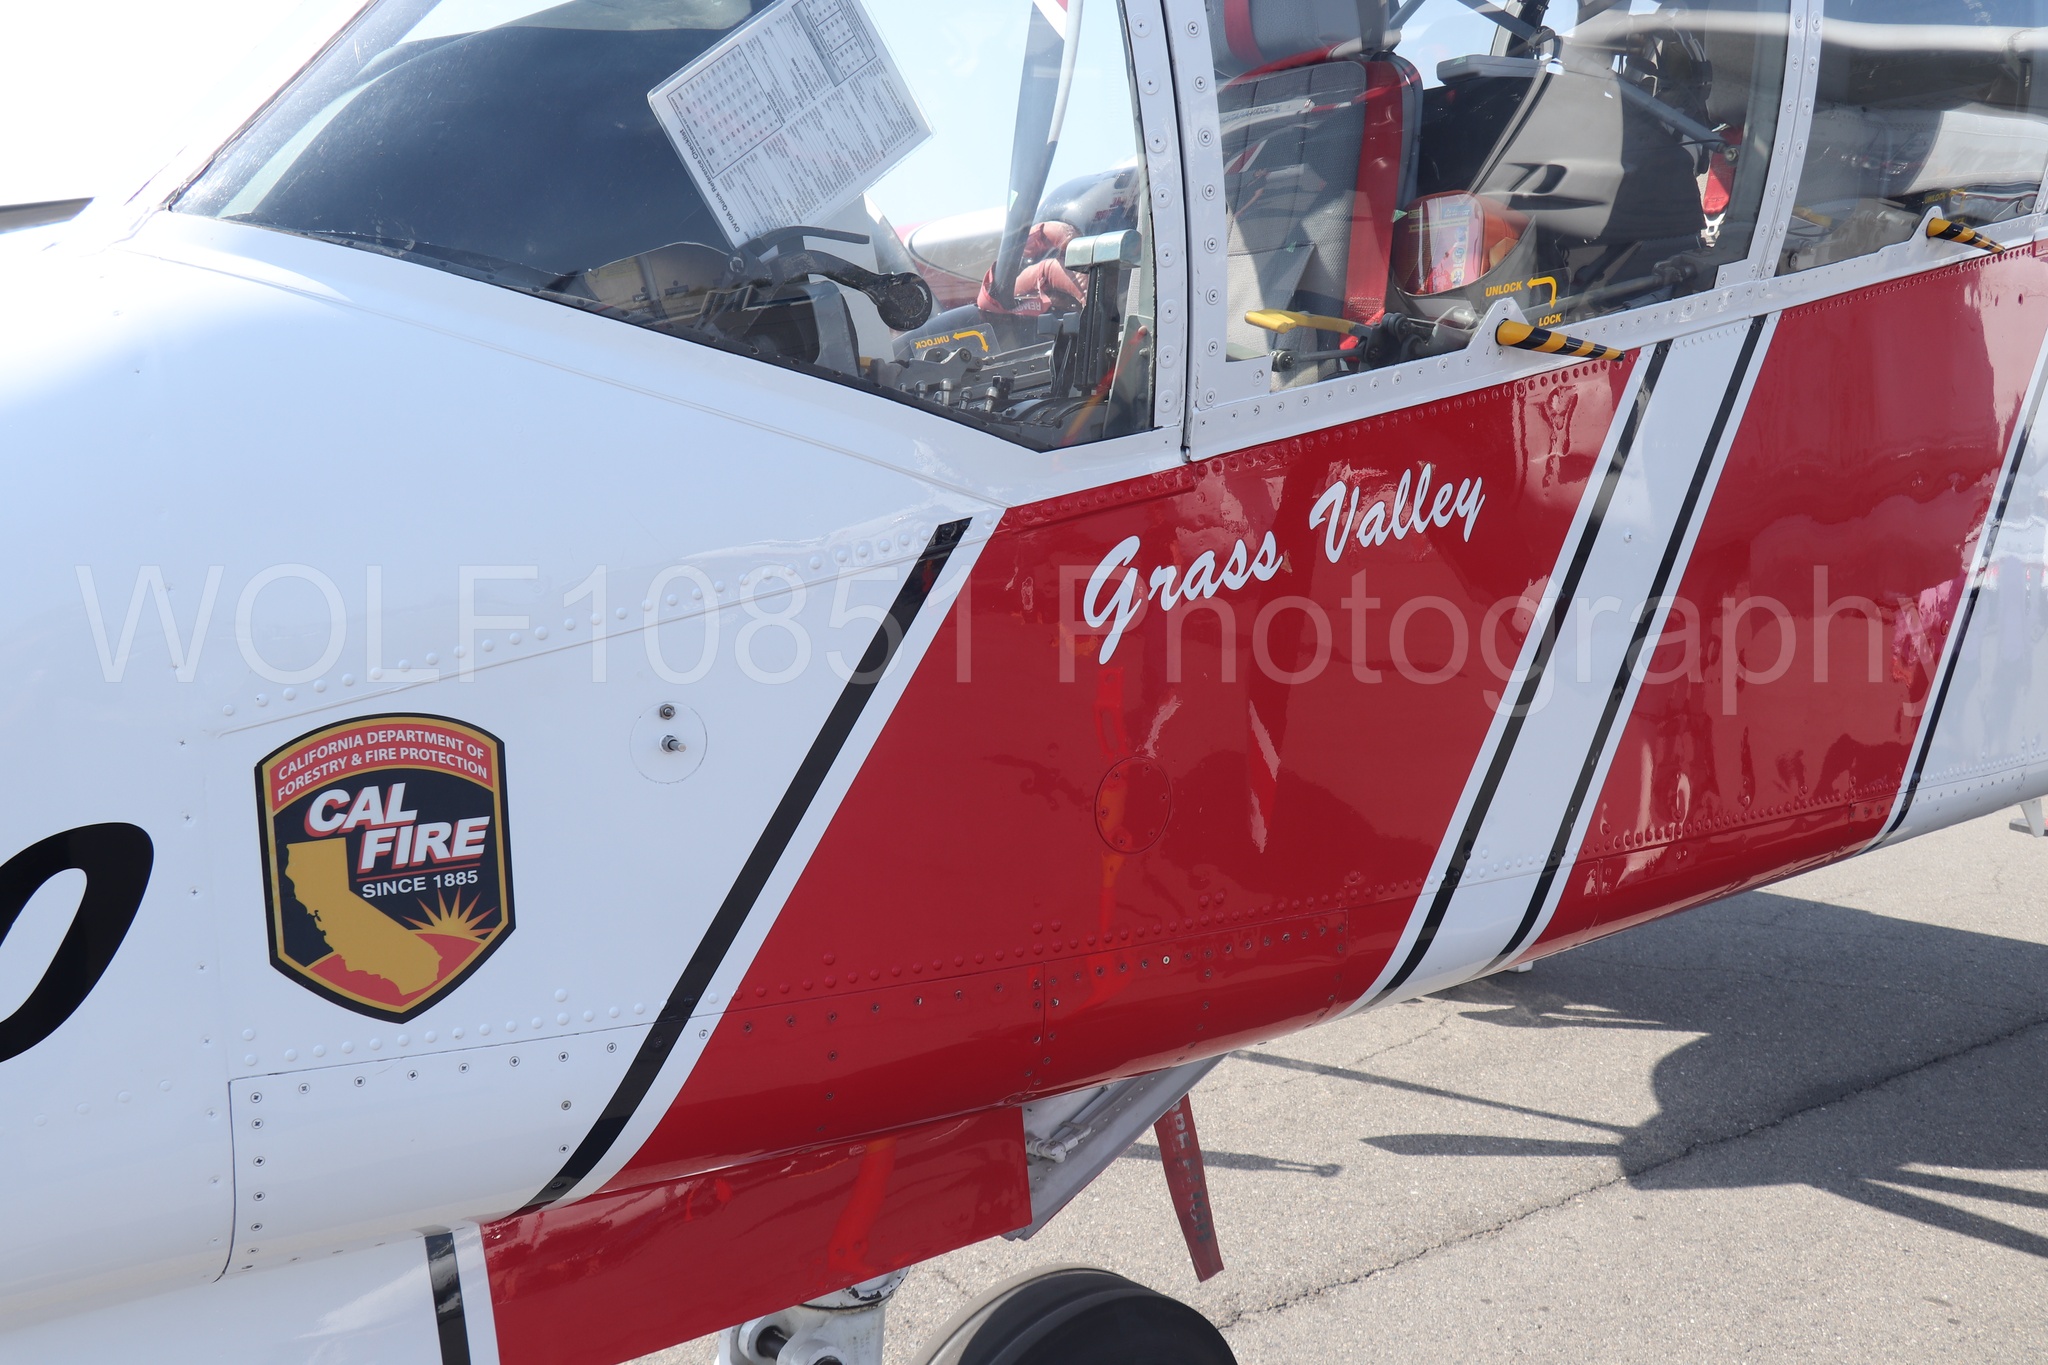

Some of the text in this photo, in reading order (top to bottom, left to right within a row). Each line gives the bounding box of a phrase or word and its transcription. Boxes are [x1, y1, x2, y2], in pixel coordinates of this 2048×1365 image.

[680, 129, 740, 233] OV10A Quick Reference Checklist
[1485, 281, 1524, 297] UNLOCK
[1539, 313, 1562, 327] LOCK
[1082, 463, 1486, 665] Grass Valley
[277, 747, 488, 802] FORESTRY & FIRE PROTECTION
[278, 729, 485, 781] CALIFORNIA DEPARTMENT OF
[304, 783, 418, 837] CAL
[357, 816, 490, 874] FIRE
[361, 870, 479, 899] SINCE 1885
